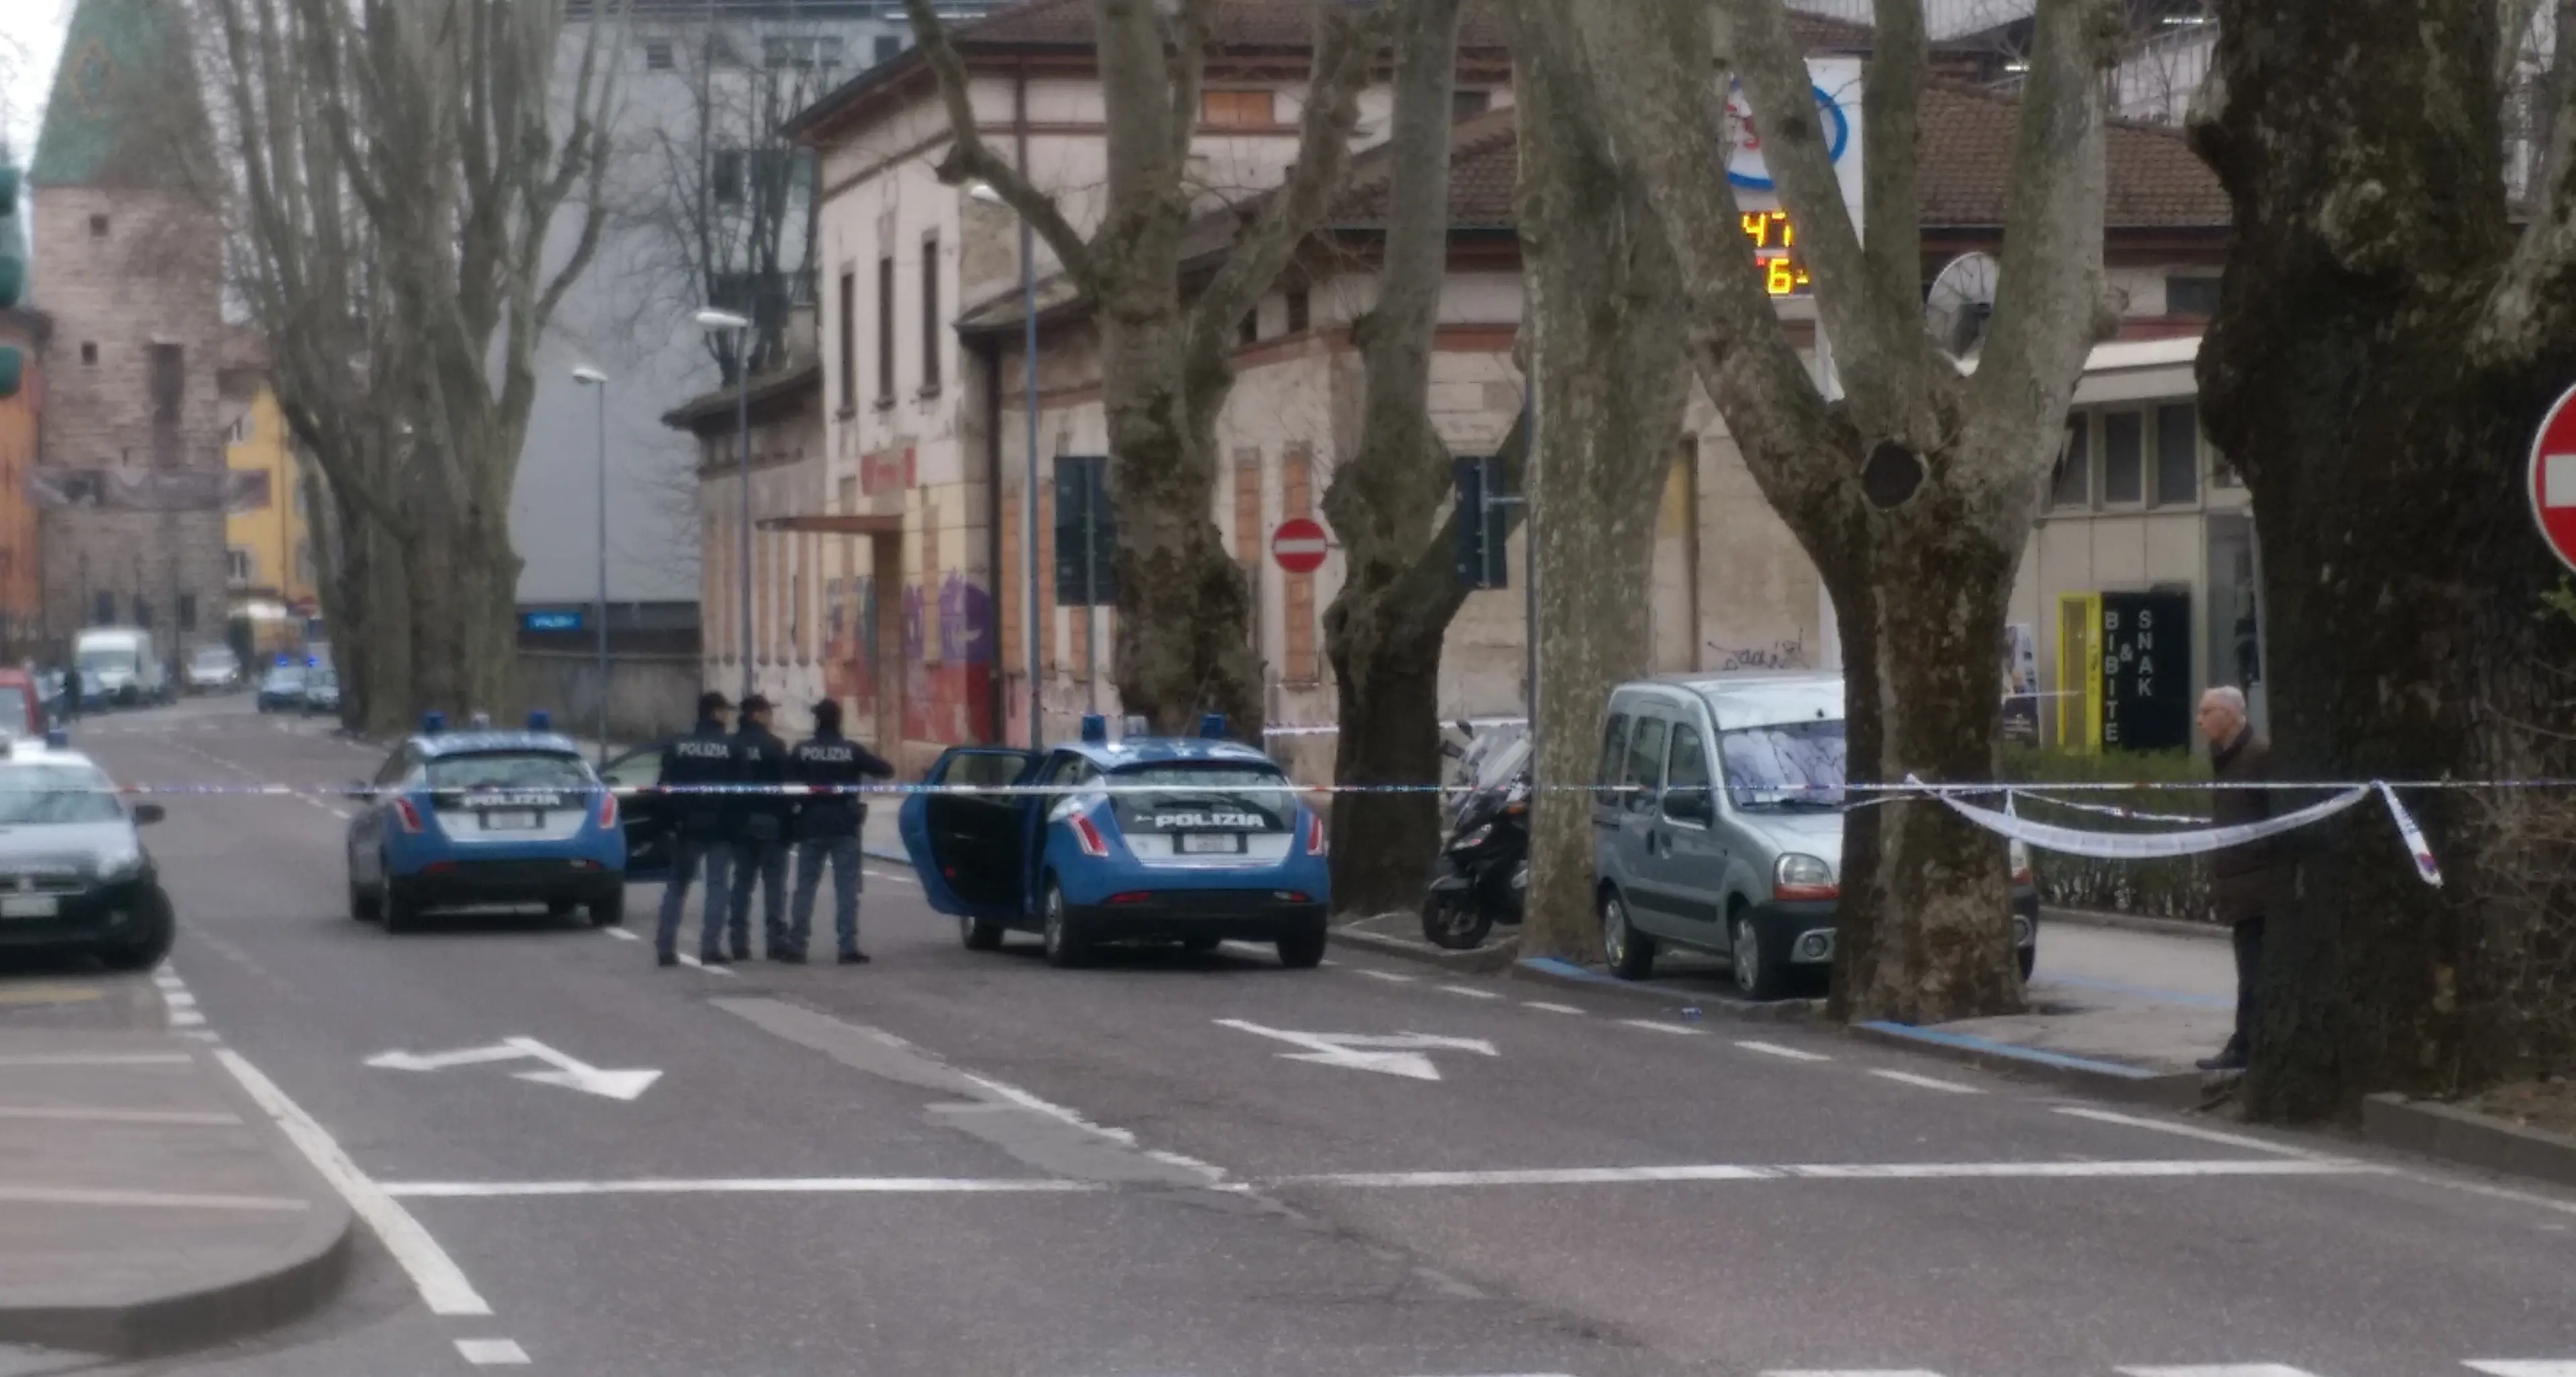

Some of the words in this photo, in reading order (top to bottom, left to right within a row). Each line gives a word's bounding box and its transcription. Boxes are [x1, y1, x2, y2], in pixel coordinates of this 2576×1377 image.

[2138, 609, 2153, 696] SNAK
[2105, 611, 2119, 742] BIBITE
[677, 742, 729, 759] POLIZIA
[800, 747, 853, 761] POLIZIA
[1155, 813, 1265, 828] POLIZIA
